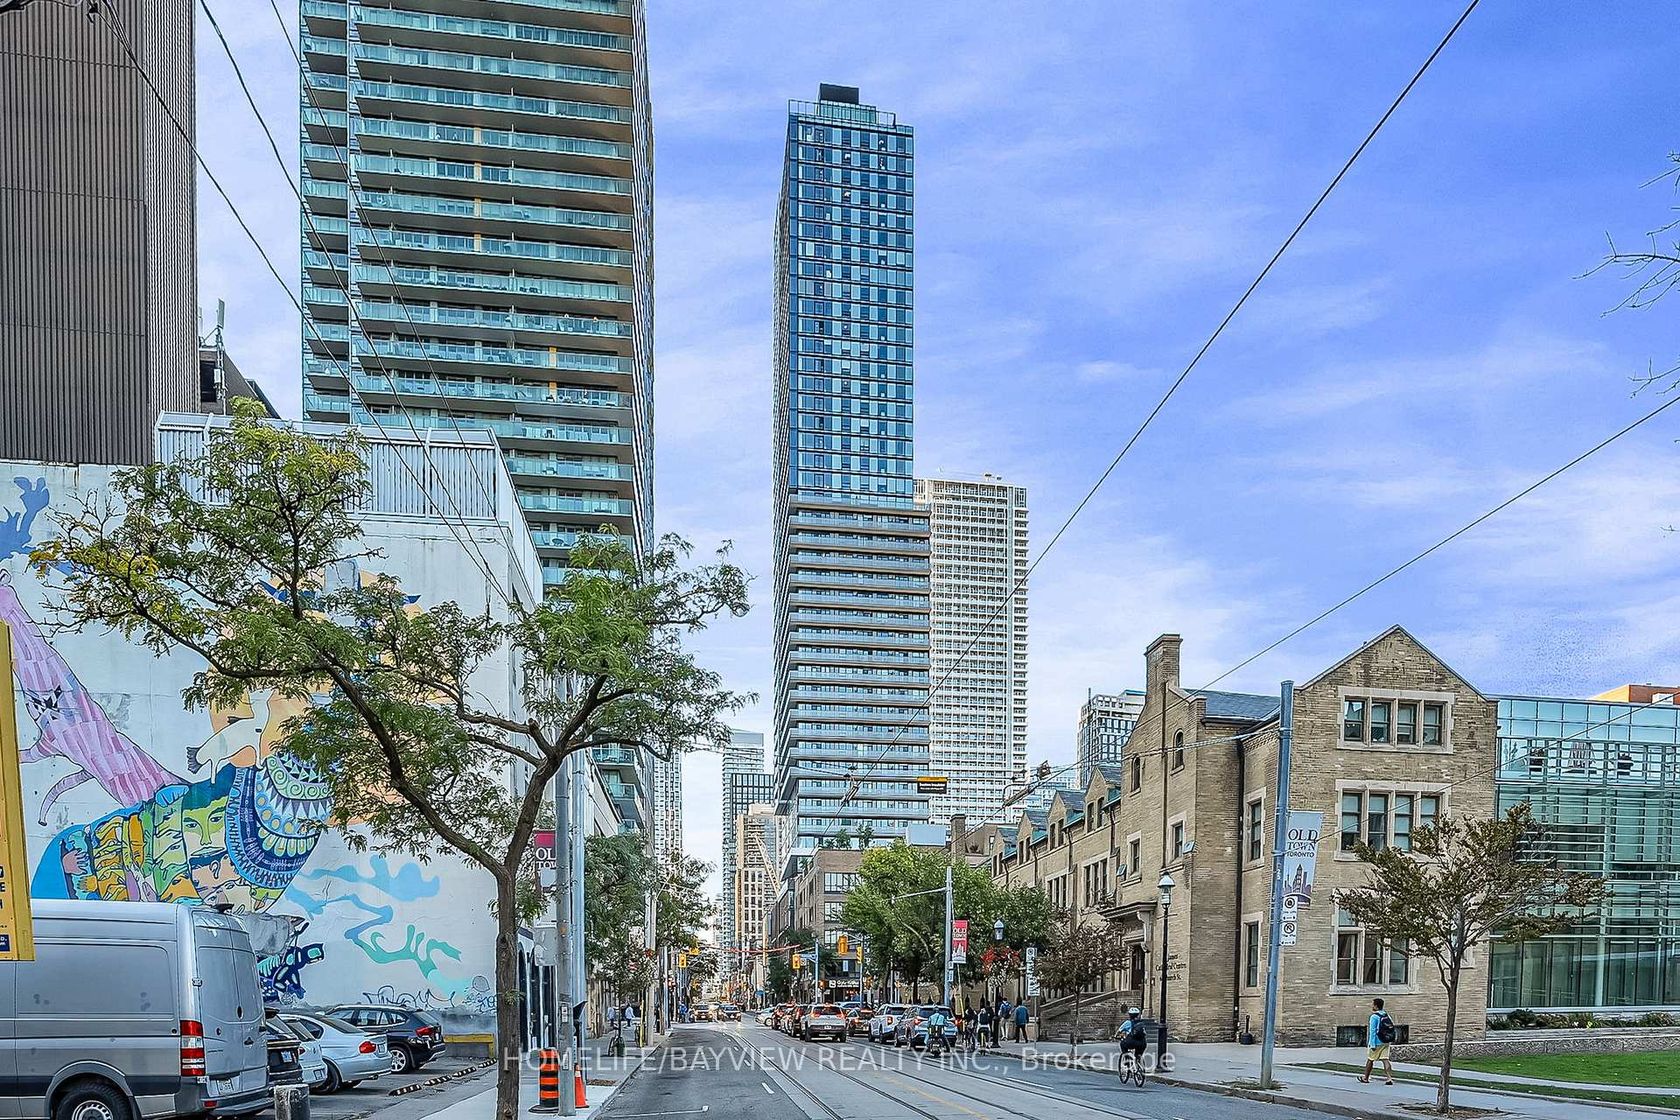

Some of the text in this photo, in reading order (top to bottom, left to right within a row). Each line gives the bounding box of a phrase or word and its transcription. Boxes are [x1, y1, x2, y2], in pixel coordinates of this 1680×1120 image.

[1288, 828, 1318, 841] OLD
[1287, 841, 1316, 852] TOWN
[536, 847, 557, 860] OL
